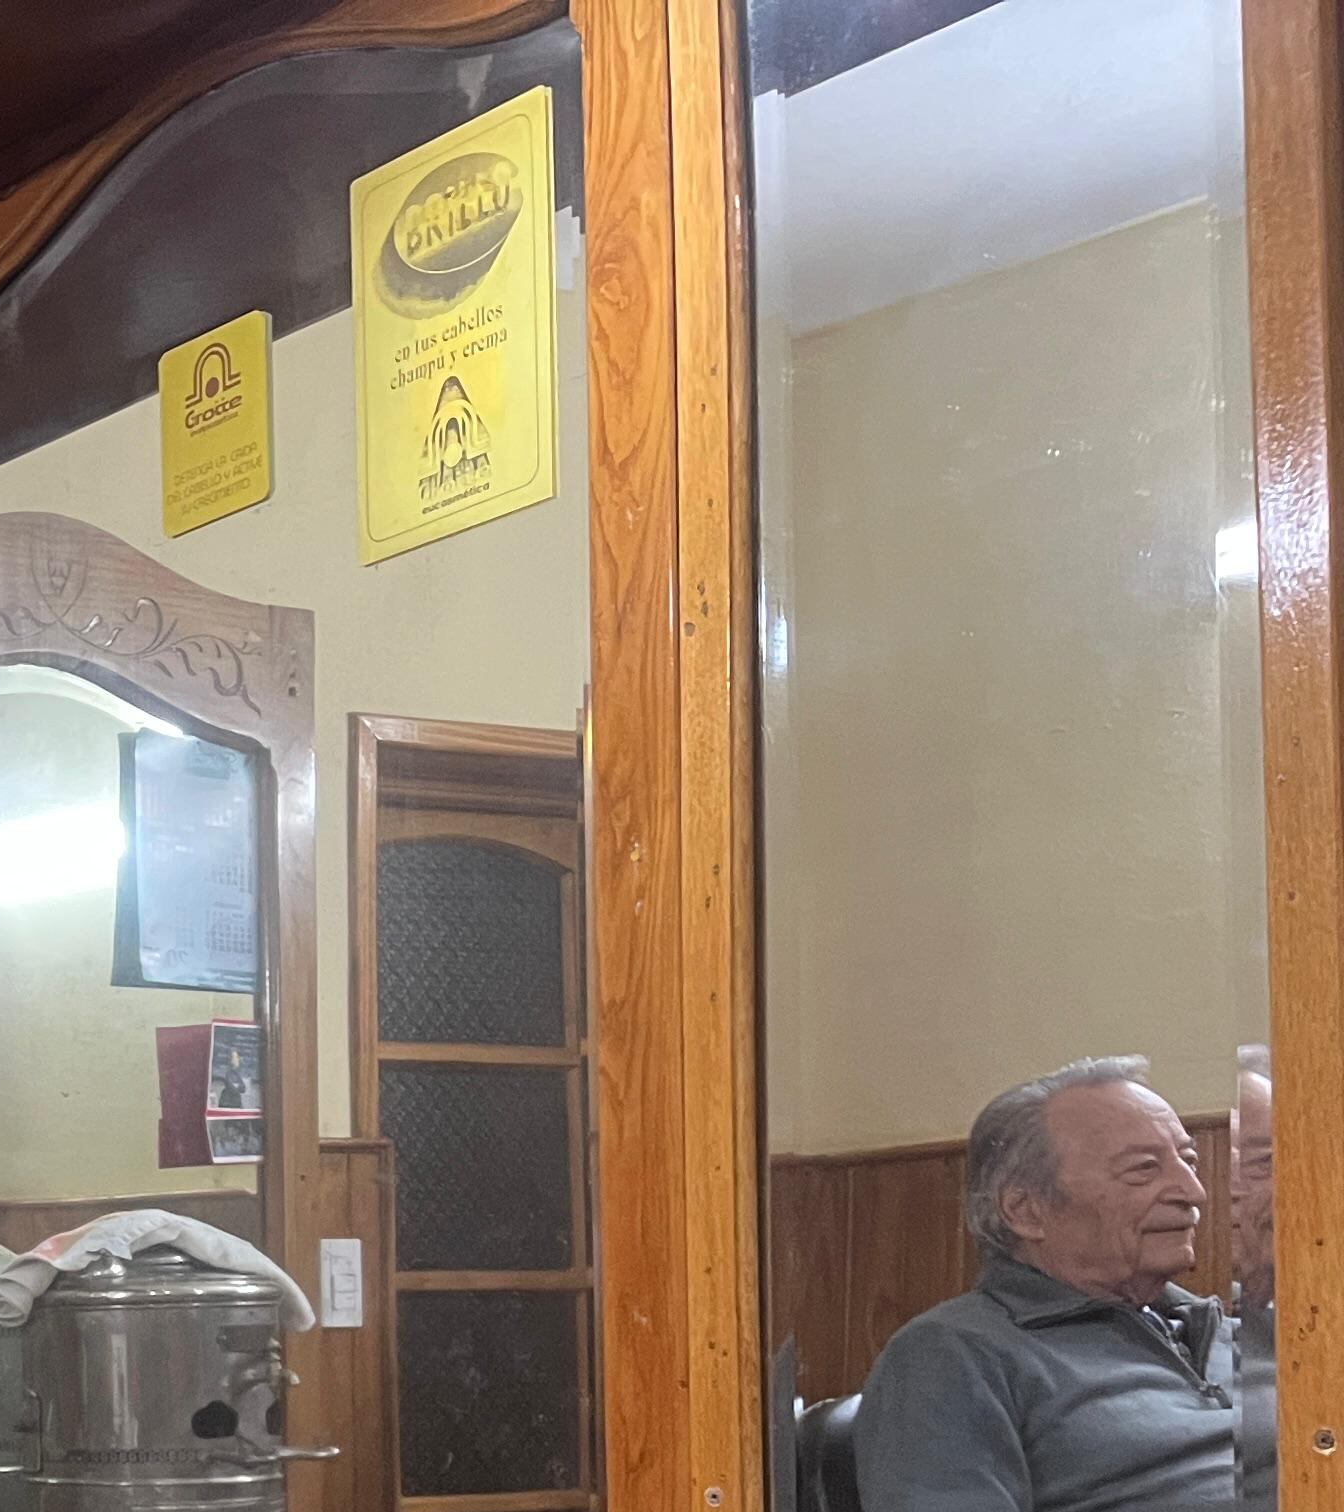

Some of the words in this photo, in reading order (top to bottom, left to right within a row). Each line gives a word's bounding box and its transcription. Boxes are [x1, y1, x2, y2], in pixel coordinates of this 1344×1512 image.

[395, 346, 410, 363] en
[415, 334, 437, 354] tus
[442, 305, 503, 341] cabellos
[449, 350, 457, 370] y
[463, 328, 507, 357] crema
